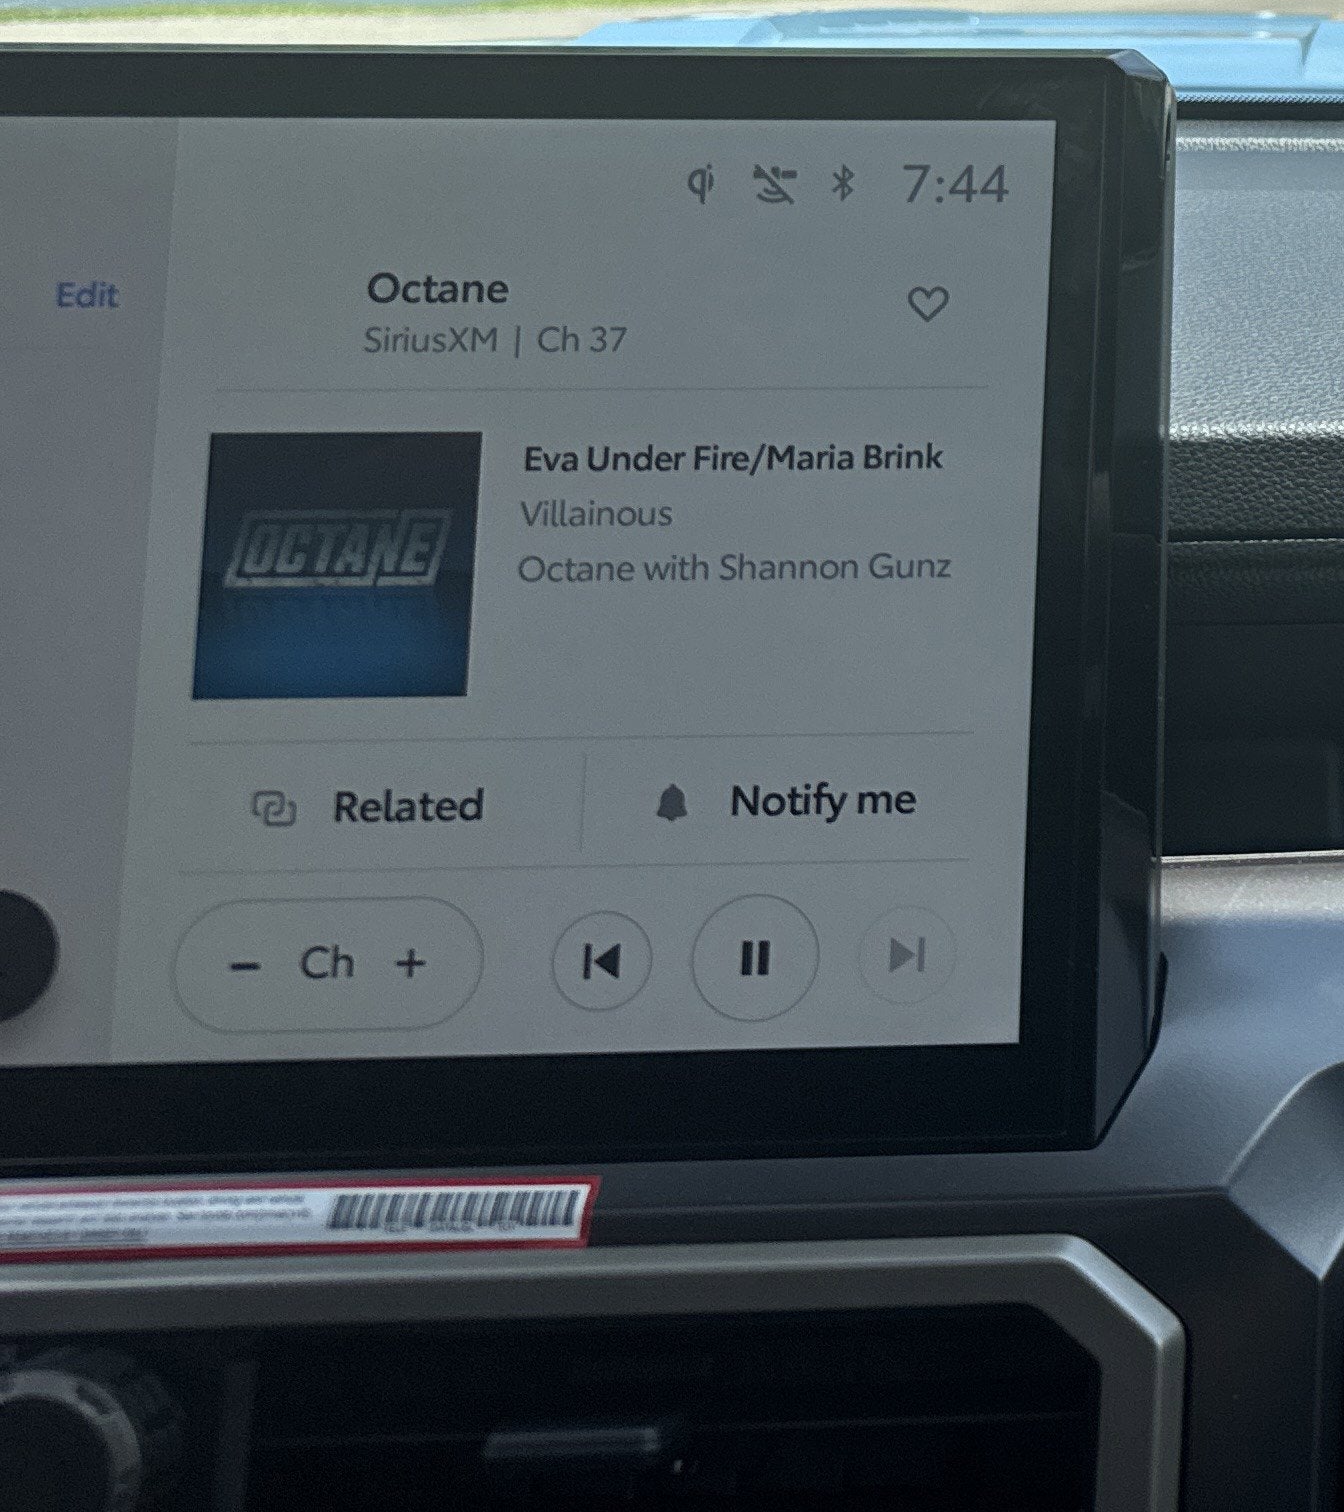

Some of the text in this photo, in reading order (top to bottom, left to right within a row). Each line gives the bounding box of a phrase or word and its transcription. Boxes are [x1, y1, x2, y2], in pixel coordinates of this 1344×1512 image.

[904, 164, 1010, 203] 7:44
[56, 281, 120, 309] Edit
[366, 271, 510, 304] Octane
[363, 324, 499, 355] SiriusXM
[537, 325, 580, 354] Ch
[588, 325, 628, 354] 37
[523, 441, 944, 476] Eva Under Fire/Maria Brink
[520, 499, 674, 528] Villainous
[243, 521, 439, 576] OCTANE
[517, 551, 952, 583] Octane with Shannon Gunz
[333, 787, 485, 824] Related
[731, 783, 918, 824] Notify me
[301, 945, 355, 980] Ch
